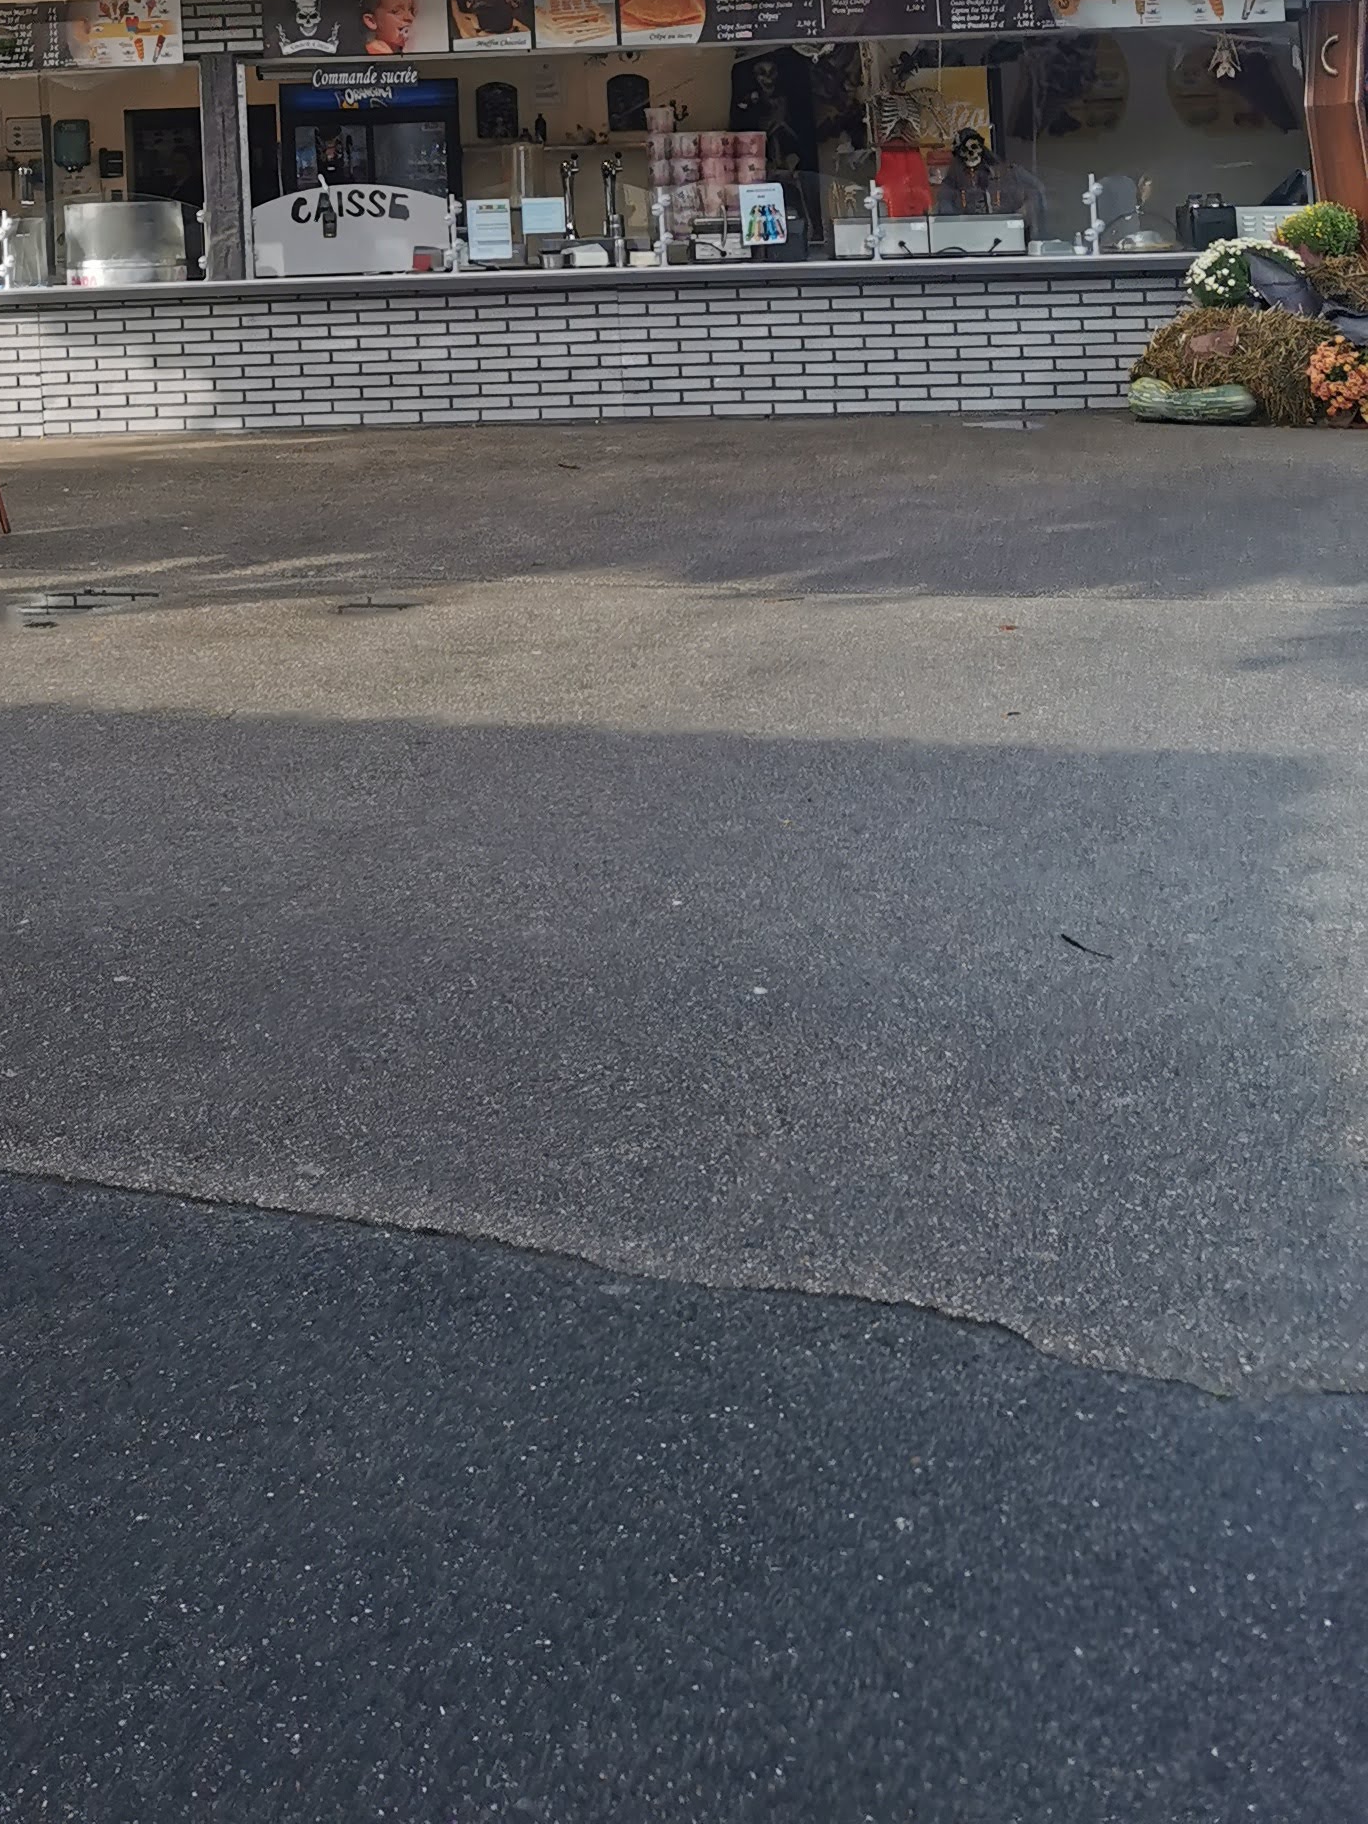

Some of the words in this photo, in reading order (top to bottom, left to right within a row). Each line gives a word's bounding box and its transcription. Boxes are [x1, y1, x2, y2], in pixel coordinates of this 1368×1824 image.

[312, 65, 377, 87] Commande
[380, 66, 419, 84] sucrée
[344, 86, 393, 104] ORANGINA
[291, 189, 410, 223] CAISSE
